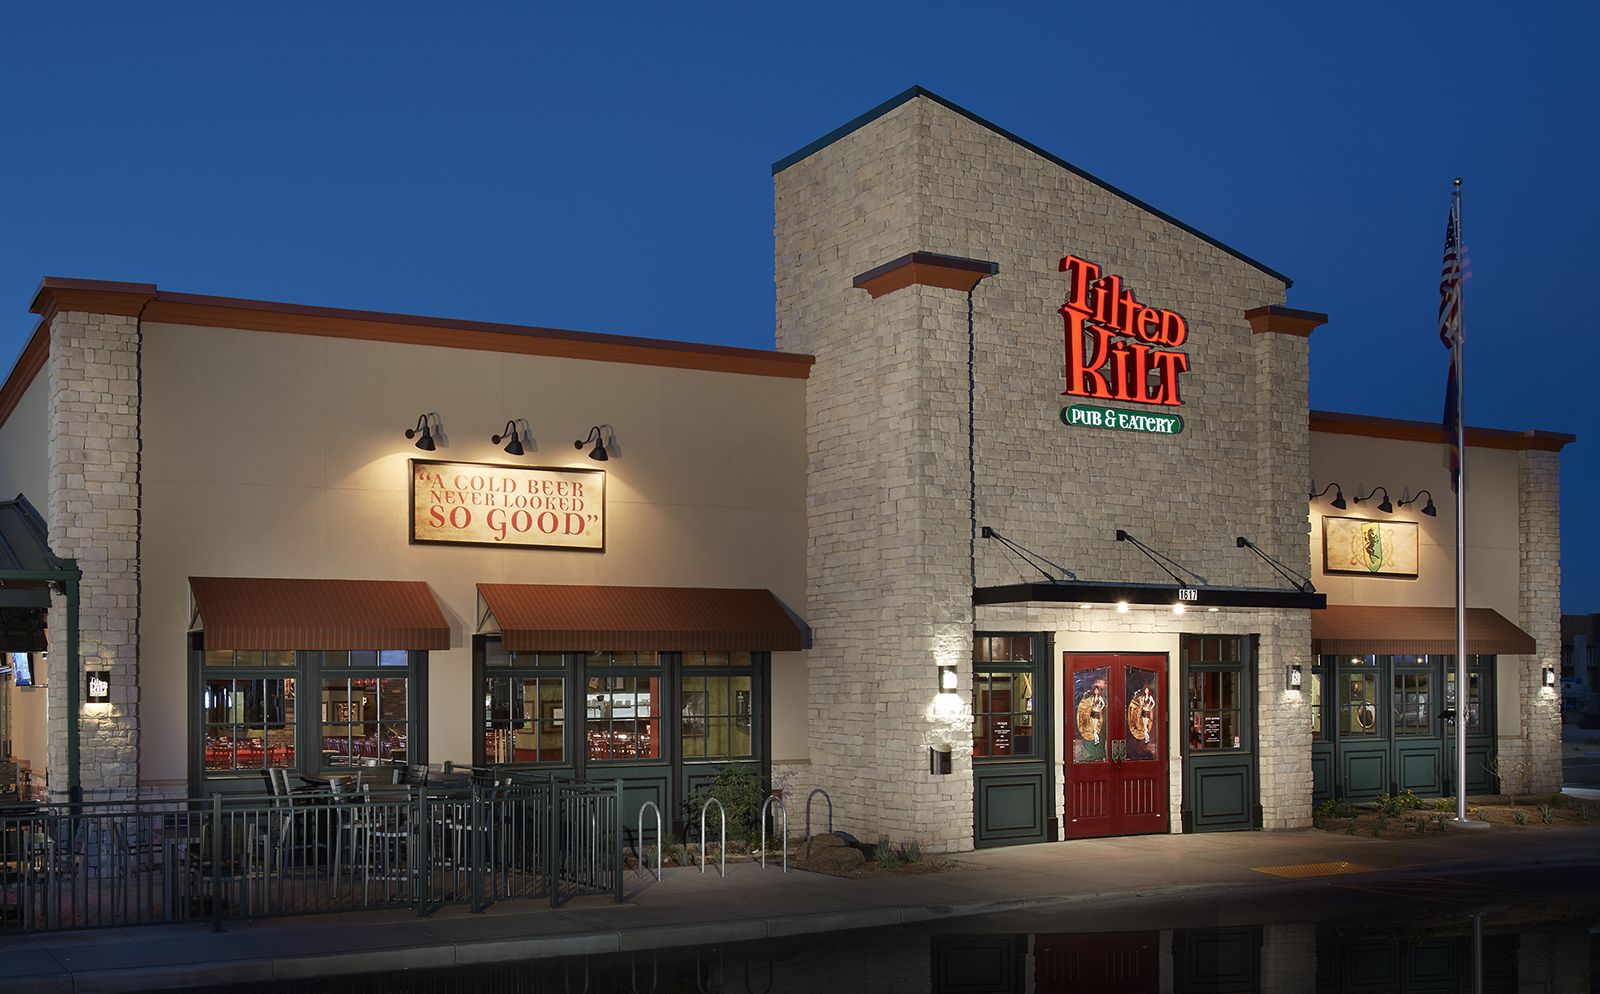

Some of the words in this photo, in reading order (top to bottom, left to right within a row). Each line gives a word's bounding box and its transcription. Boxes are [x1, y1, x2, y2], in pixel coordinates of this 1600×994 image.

[1072, 408, 1102, 426] PUB
[1105, 409, 1117, 427] &
[454, 475, 517, 493] COLD
[528, 479, 584, 497] BEER
[430, 490, 495, 506] NEVER
[503, 494, 585, 512] LOOKED
[429, 504, 472, 530] SO
[1180, 590, 1196, 600] 1617
